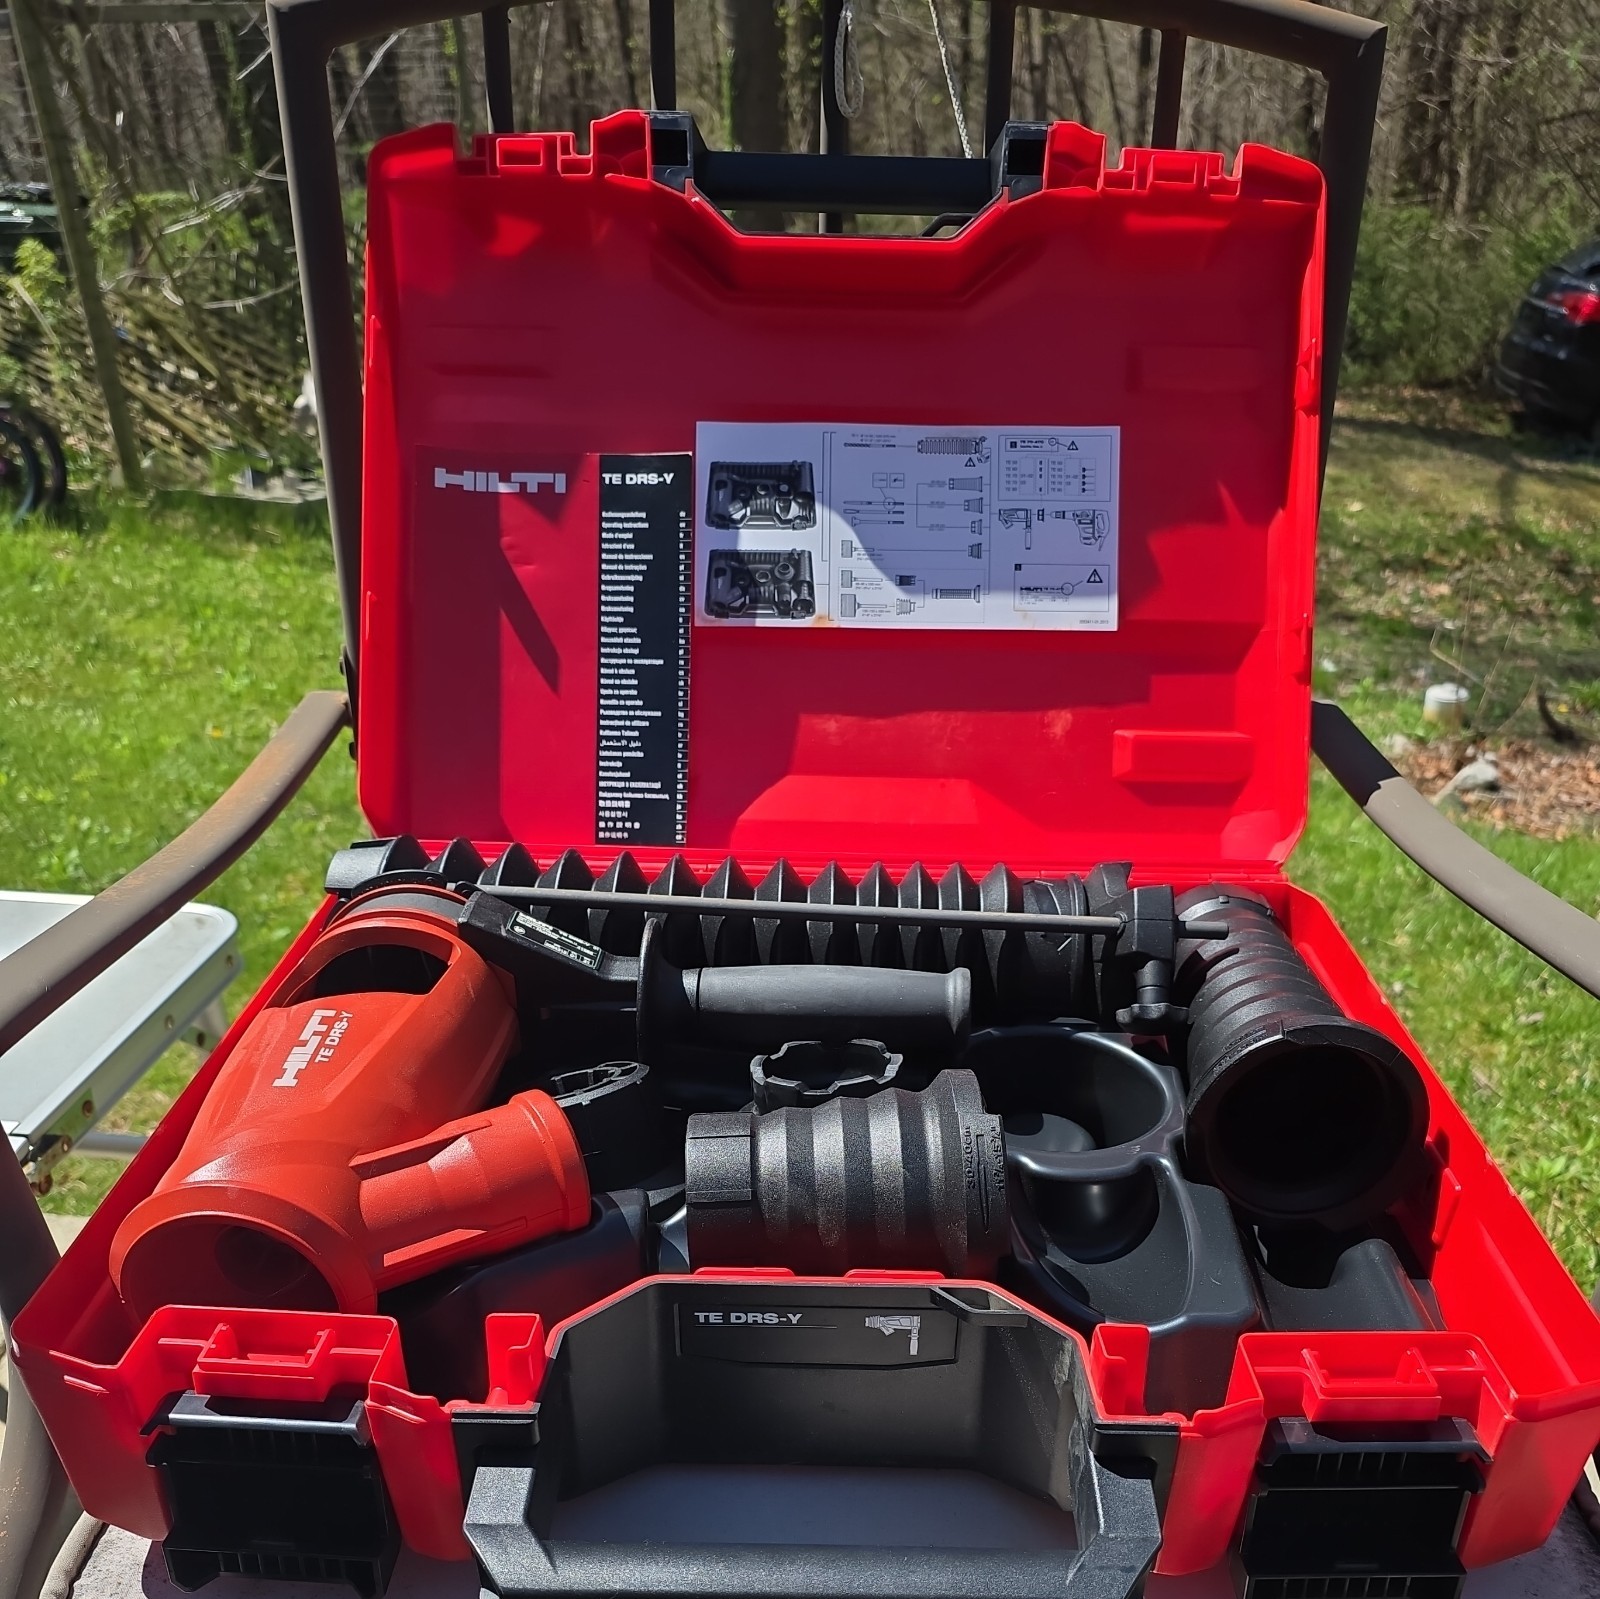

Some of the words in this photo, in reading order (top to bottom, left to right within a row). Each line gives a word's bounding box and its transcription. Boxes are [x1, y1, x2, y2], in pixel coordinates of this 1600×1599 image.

[435, 467, 566, 494] HILTI
[602, 473, 622, 485] TE
[625, 473, 674, 485] DRS-Y
[324, 1010, 353, 1046] DRS-Y
[272, 1009, 337, 1087] HILTI
[314, 1047, 335, 1063] TE
[694, 1312, 723, 1324] TE
[730, 1312, 802, 1325] DRS-Y
